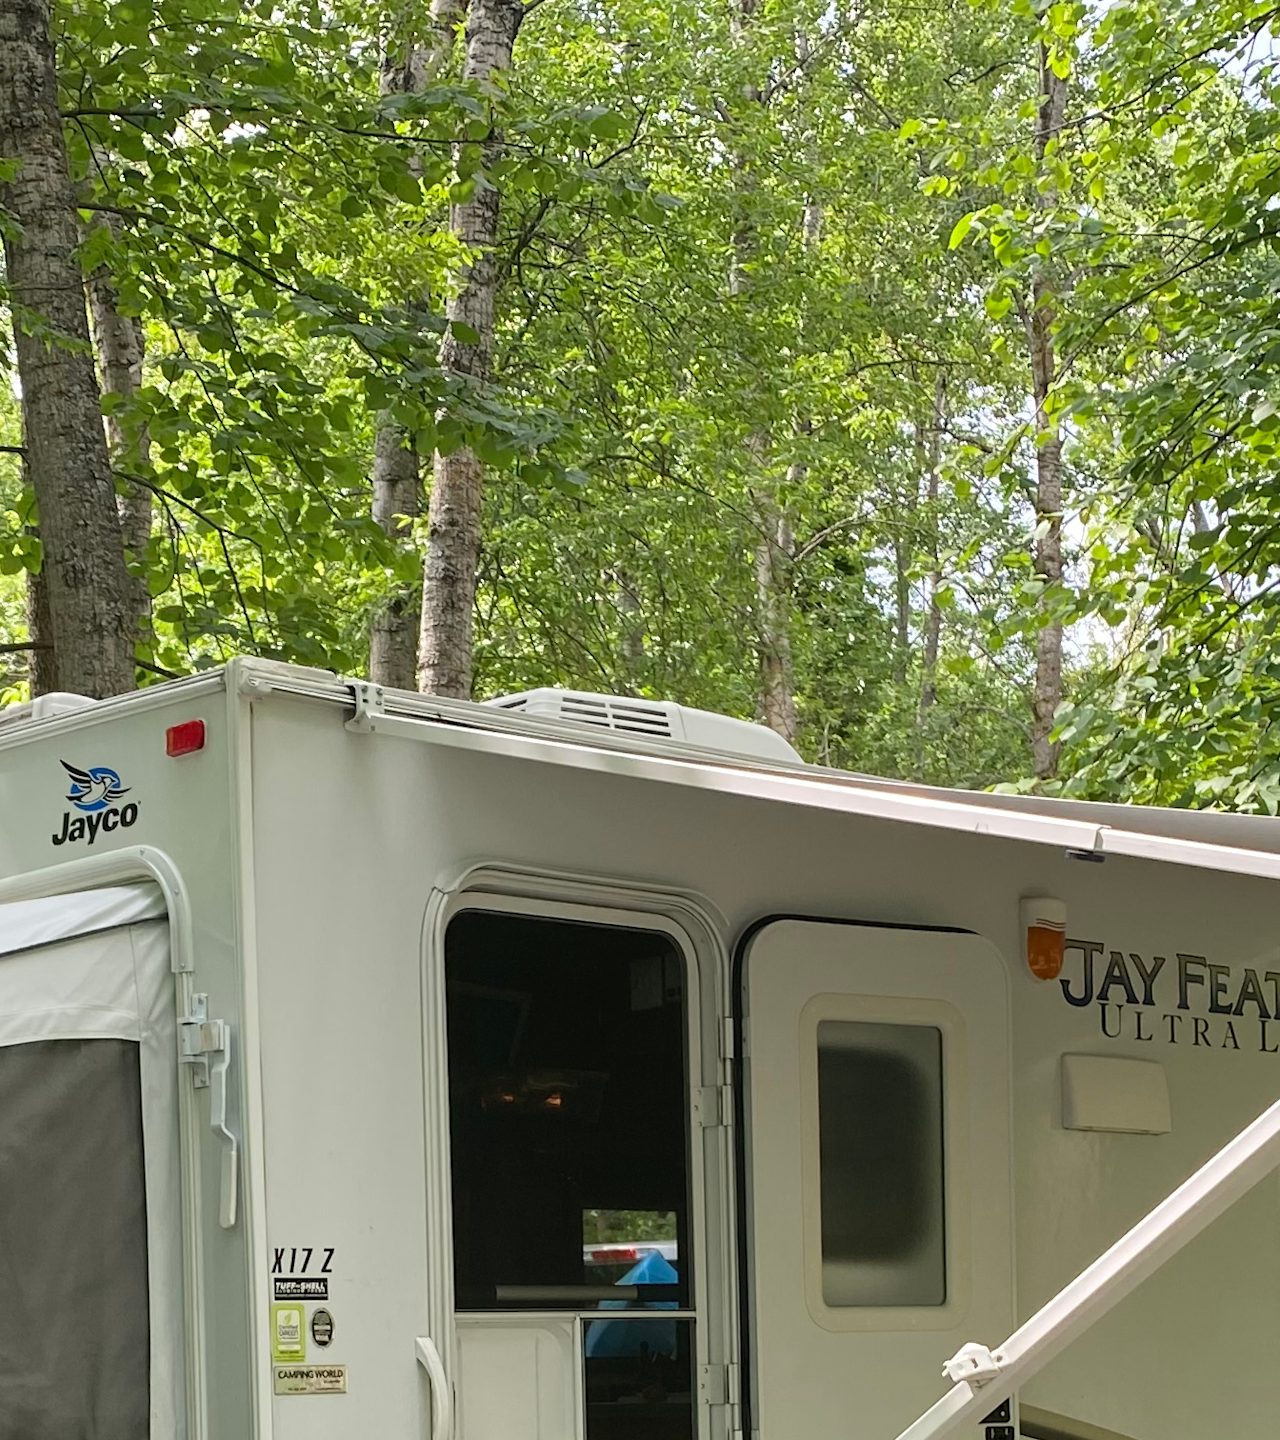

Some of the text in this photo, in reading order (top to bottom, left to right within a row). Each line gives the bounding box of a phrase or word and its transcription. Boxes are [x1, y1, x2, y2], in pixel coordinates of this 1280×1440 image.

[52, 803, 138, 846] Jayco
[1060, 938, 1166, 1007] JAY
[1101, 1003, 1241, 1050] ULTRA
[271, 1248, 335, 1273] X17 Z
[278, 1369, 344, 1379] CAMPING WORLD
